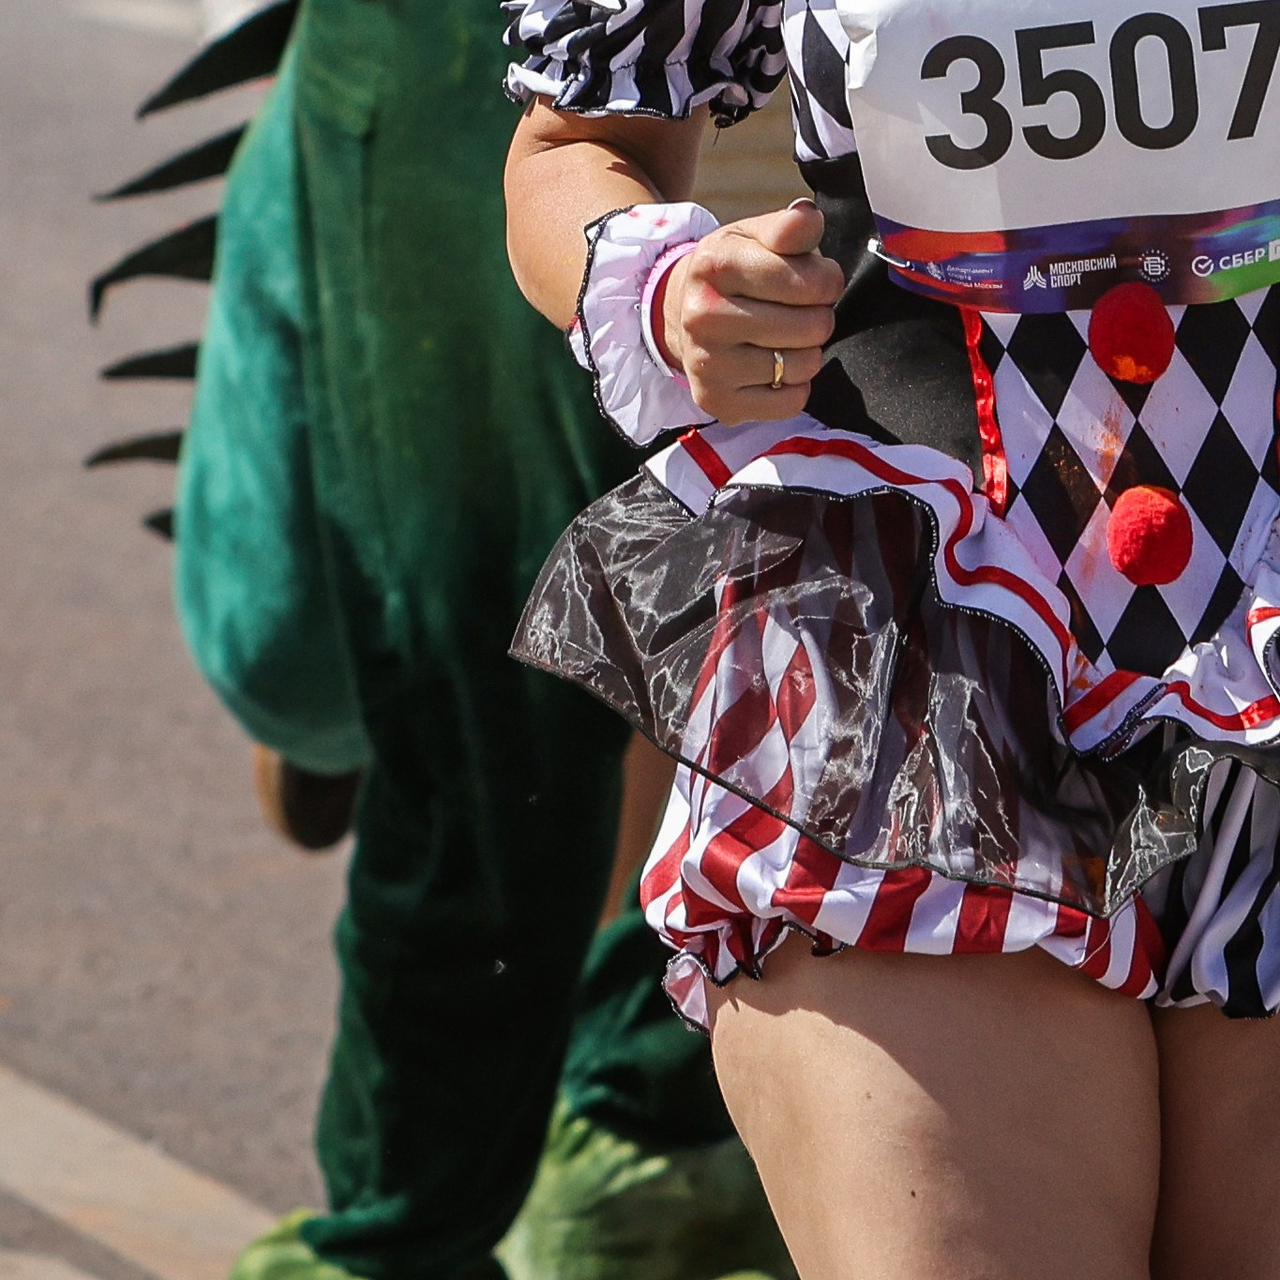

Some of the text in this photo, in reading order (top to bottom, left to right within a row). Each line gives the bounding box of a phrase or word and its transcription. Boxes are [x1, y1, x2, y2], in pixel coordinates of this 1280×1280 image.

[1049, 254, 1117, 275] МОСКОВСКИЙ
[1218, 247, 1266, 270] СБЕР
[1050, 273, 1082, 289] СПОРТ
